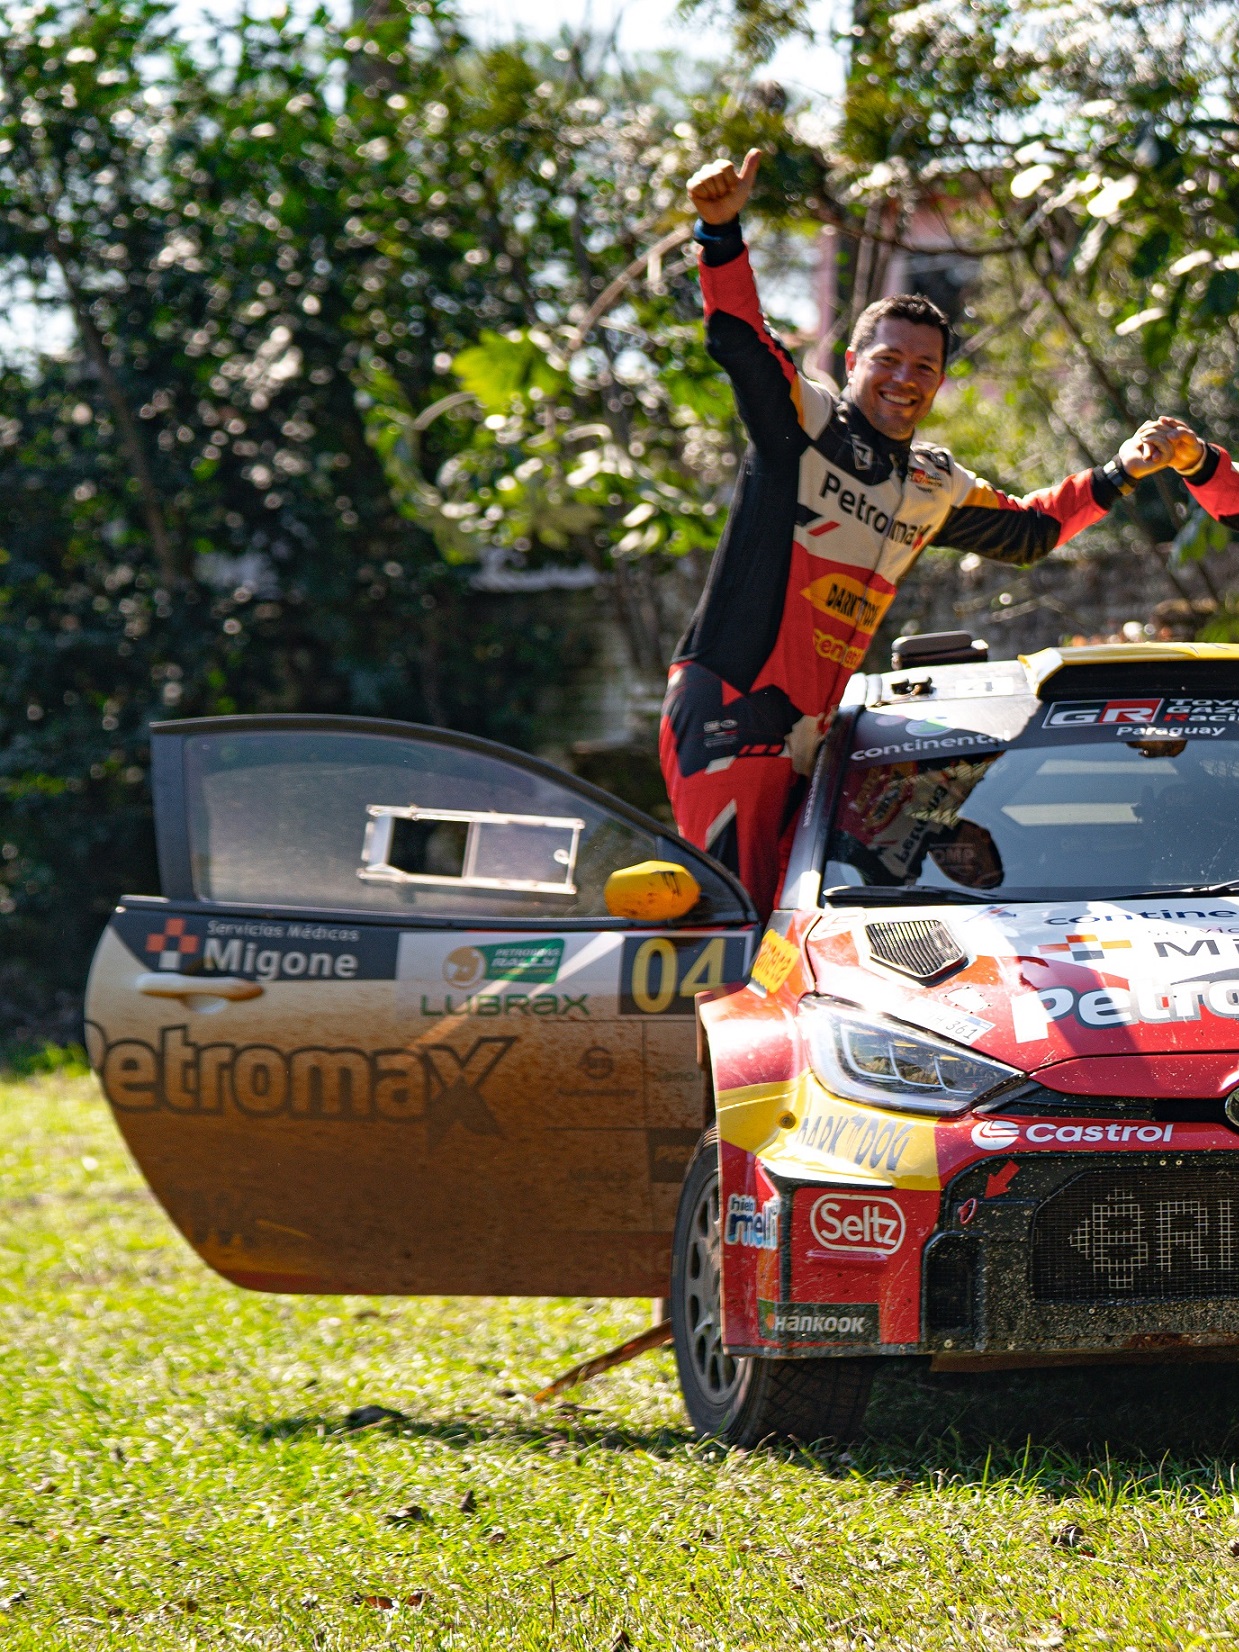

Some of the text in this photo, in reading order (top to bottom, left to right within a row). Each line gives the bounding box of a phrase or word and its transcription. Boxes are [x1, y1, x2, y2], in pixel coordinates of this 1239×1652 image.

[1050, 706, 1155, 726] GR
[1116, 725, 1226, 737] Paraguay
[207, 919, 283, 938] Servicios
[204, 937, 359, 980] Migone
[631, 937, 727, 1014] 04
[852, 1117, 915, 1171] DOG
[1025, 1123, 1174, 1143] Castrol
[820, 1202, 899, 1246] Seltz
